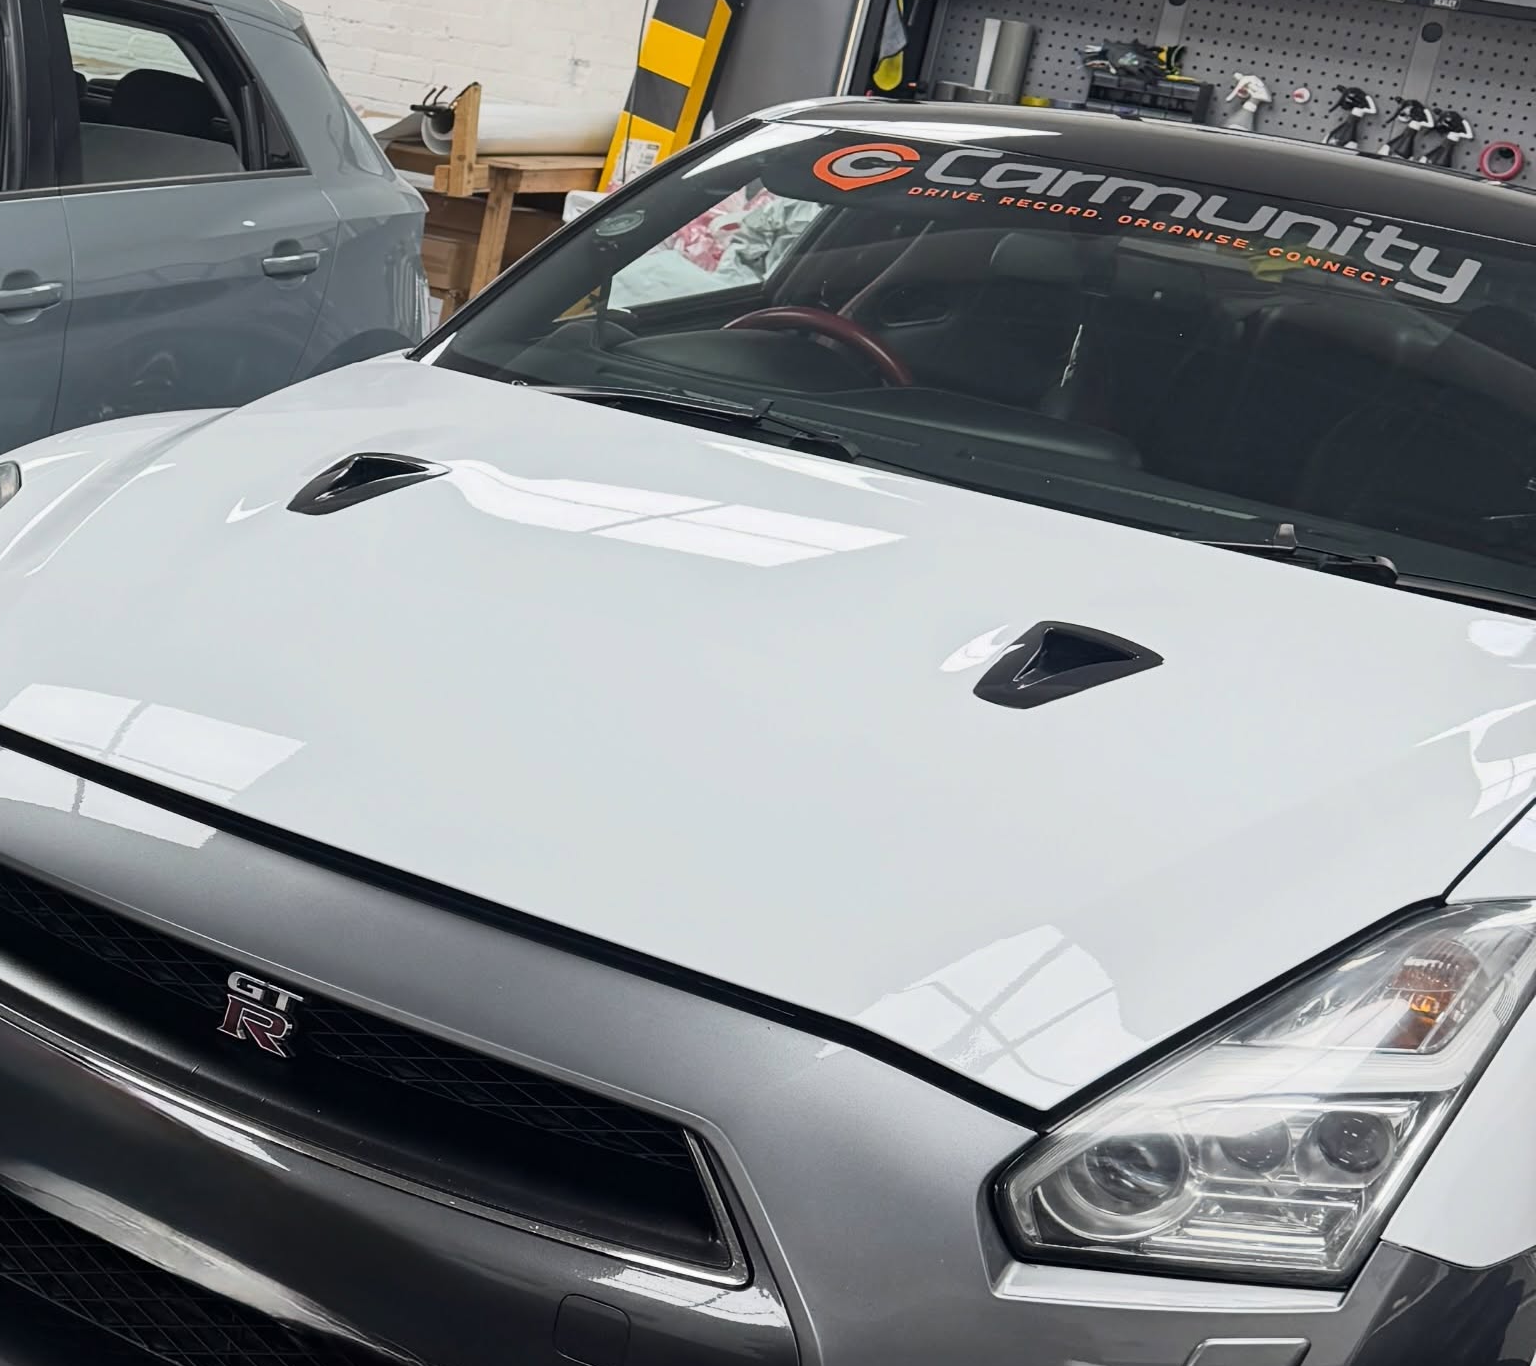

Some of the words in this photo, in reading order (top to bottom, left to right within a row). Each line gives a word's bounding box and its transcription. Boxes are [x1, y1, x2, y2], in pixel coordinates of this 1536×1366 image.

[907, 186, 987, 204] DRIVE.
[998, 195, 1103, 221] RECORD.
[1117, 214, 1255, 251] ORGANISE.
[1267, 246, 1394, 287] CONNECT
[924, 148, 1482, 304] Carmunity
[216, 993, 289, 1058] R
[227, 971, 304, 1011] GT
